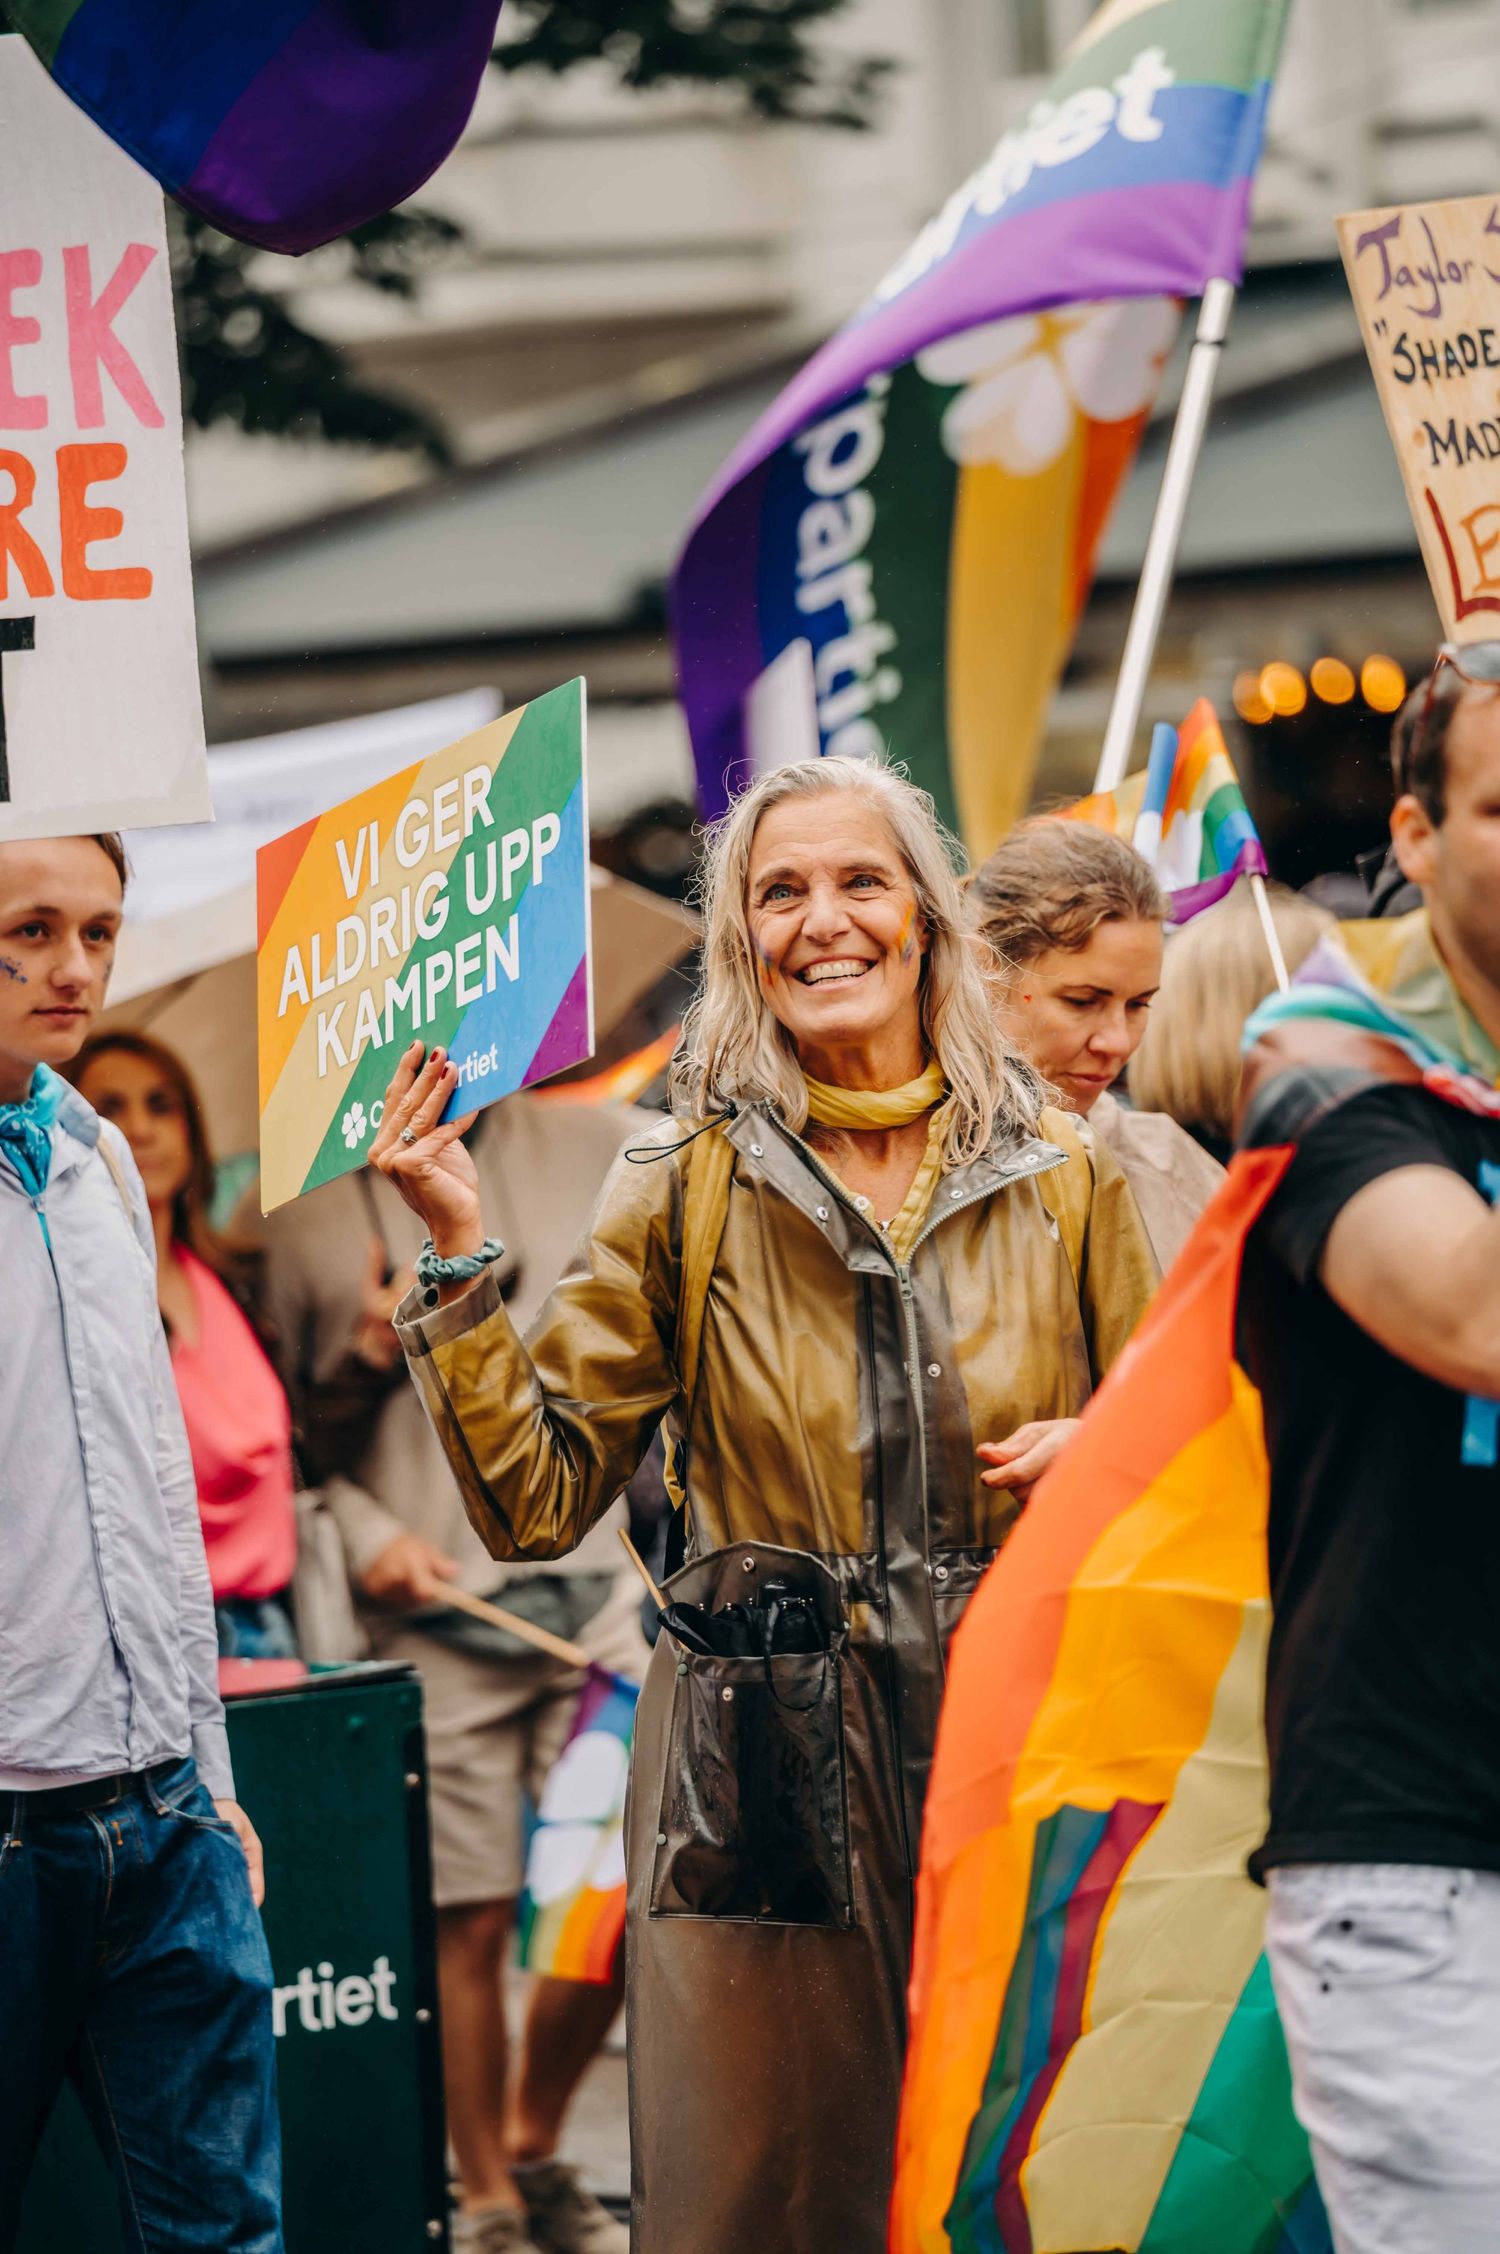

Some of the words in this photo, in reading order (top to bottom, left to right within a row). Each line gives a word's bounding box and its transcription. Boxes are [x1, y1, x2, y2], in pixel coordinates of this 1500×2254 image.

[1355, 214, 1474, 319] Taylor
[1422, 418, 1500, 465] MAD
[335, 821, 379, 899] VI
[395, 764, 495, 868] GER
[277, 869, 450, 1018] ALDRIG
[464, 811, 561, 917] UPP
[316, 913, 520, 1079] KAMPEN
